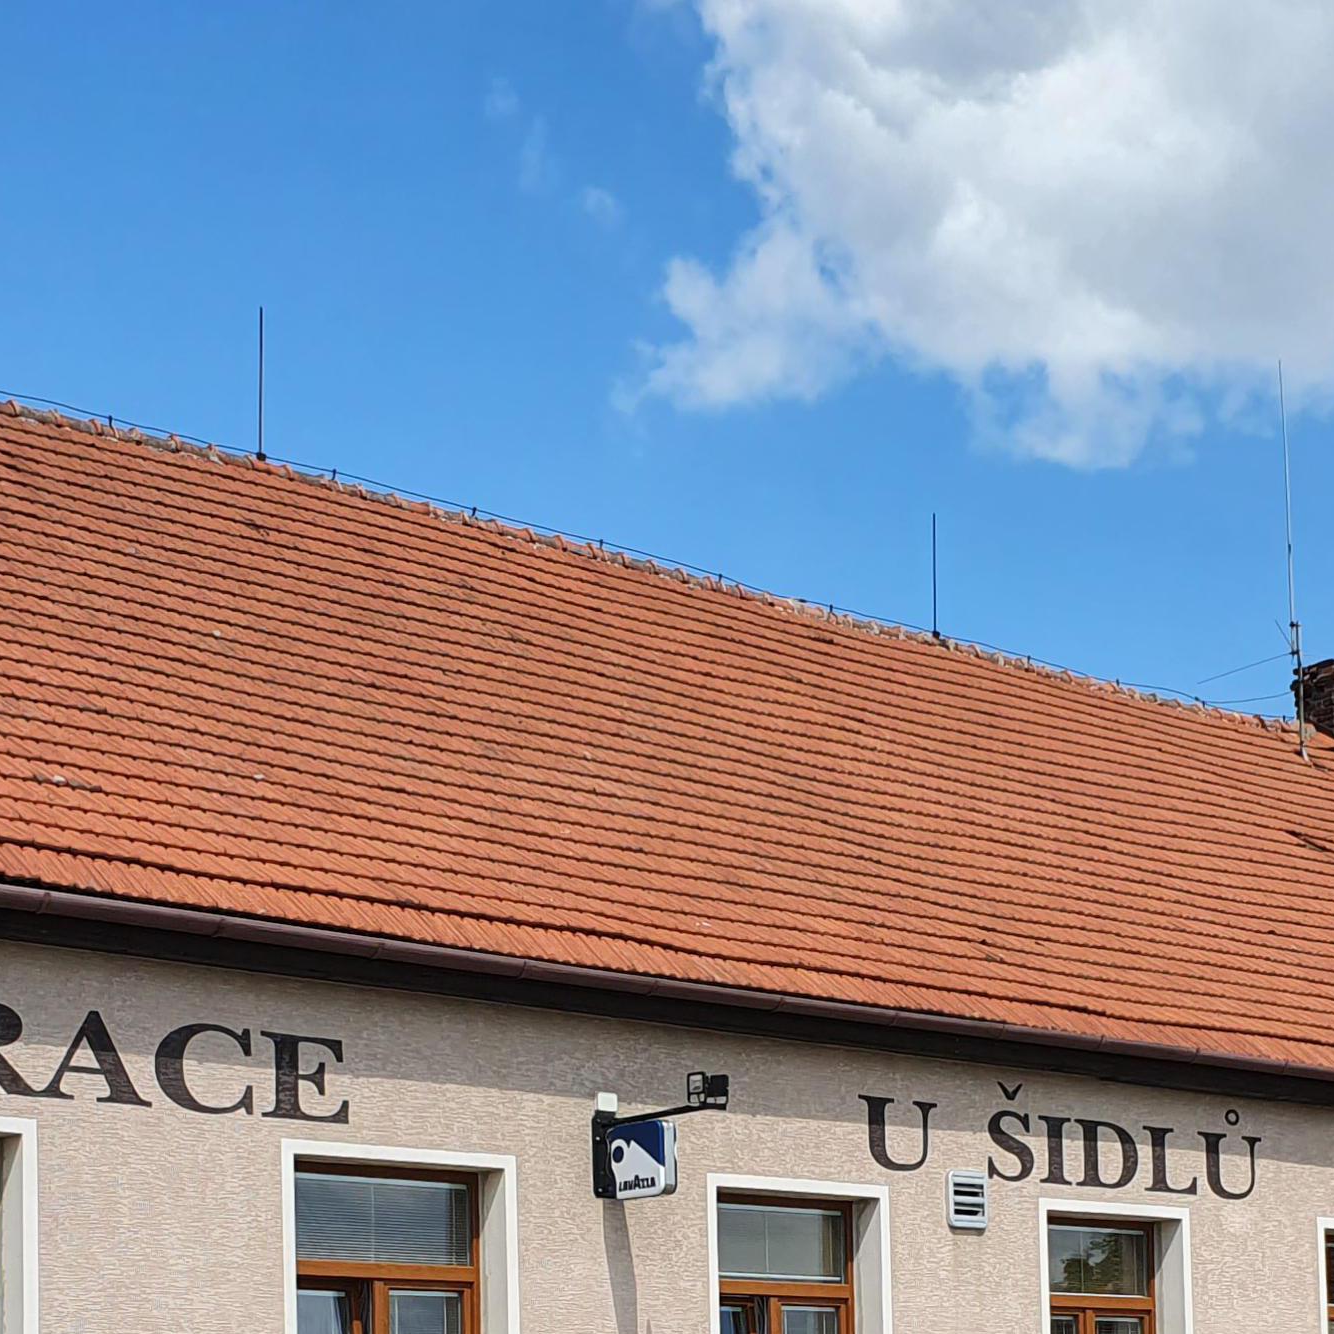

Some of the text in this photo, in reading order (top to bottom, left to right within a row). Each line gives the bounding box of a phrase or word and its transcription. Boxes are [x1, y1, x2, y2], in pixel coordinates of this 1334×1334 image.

[858, 1094, 937, 1171] U
[987, 1081, 1262, 1200] ŠIDLŮ
[619, 1174, 657, 1193] LAVAZZA
